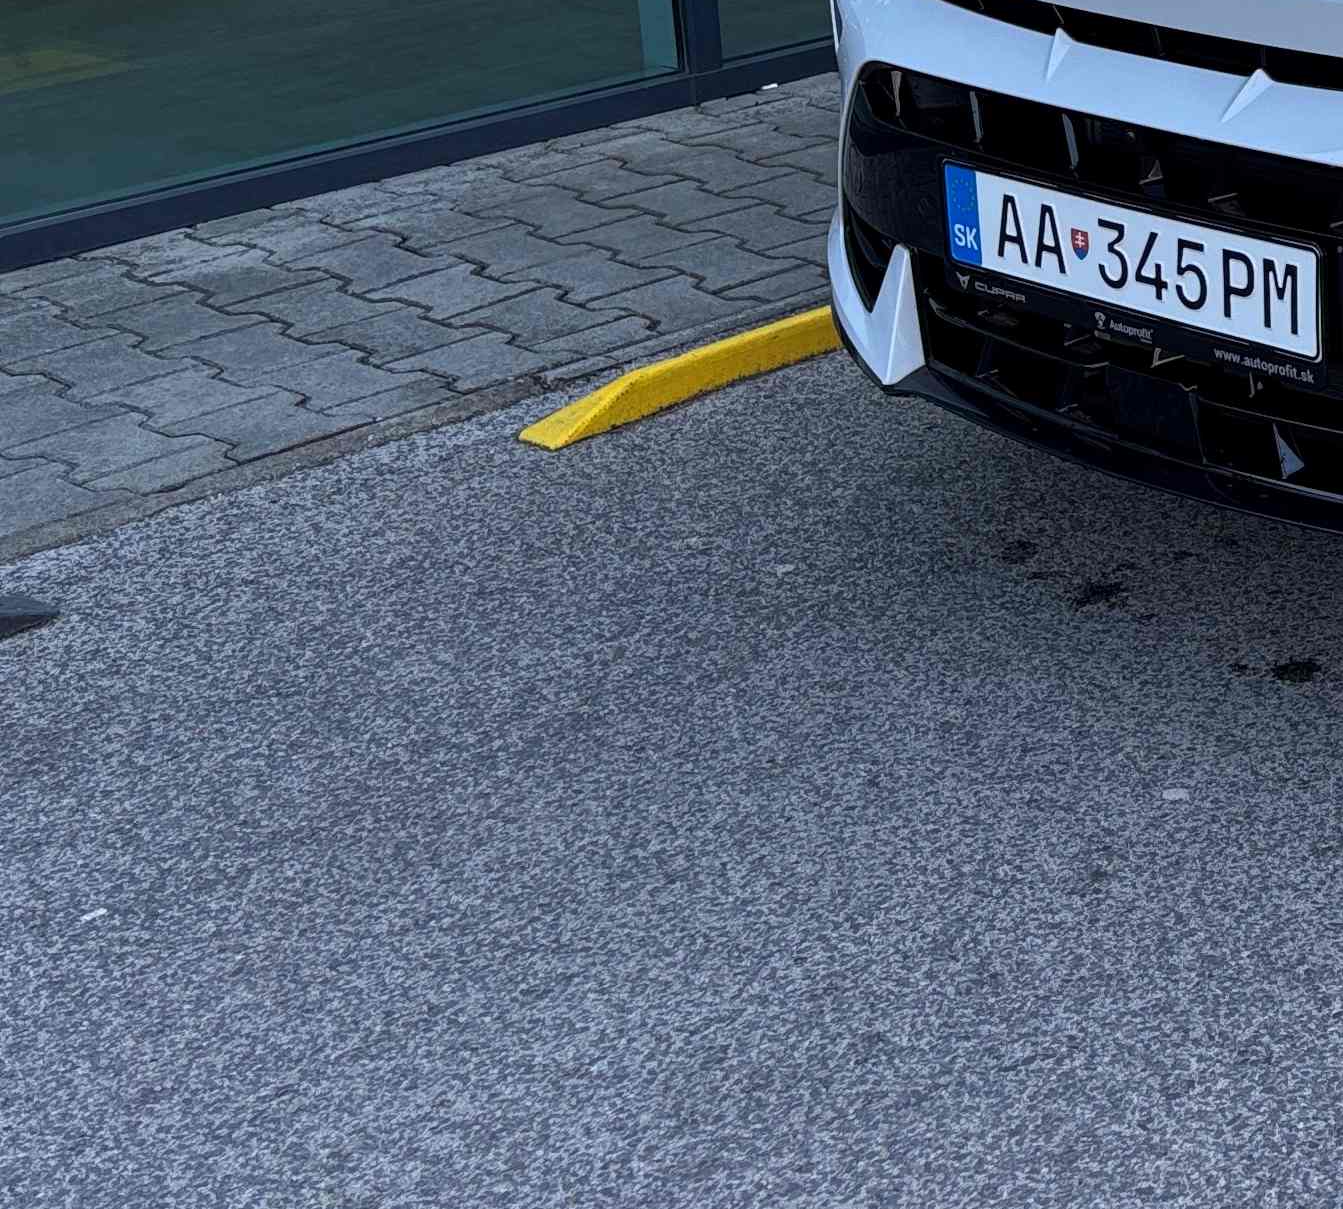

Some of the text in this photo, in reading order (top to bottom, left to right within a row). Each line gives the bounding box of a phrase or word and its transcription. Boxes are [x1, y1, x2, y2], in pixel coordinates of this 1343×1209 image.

[953, 223, 979, 251] SK
[997, 193, 1067, 274] AA
[1212, 347, 1315, 384] www.autoprofit.sk
